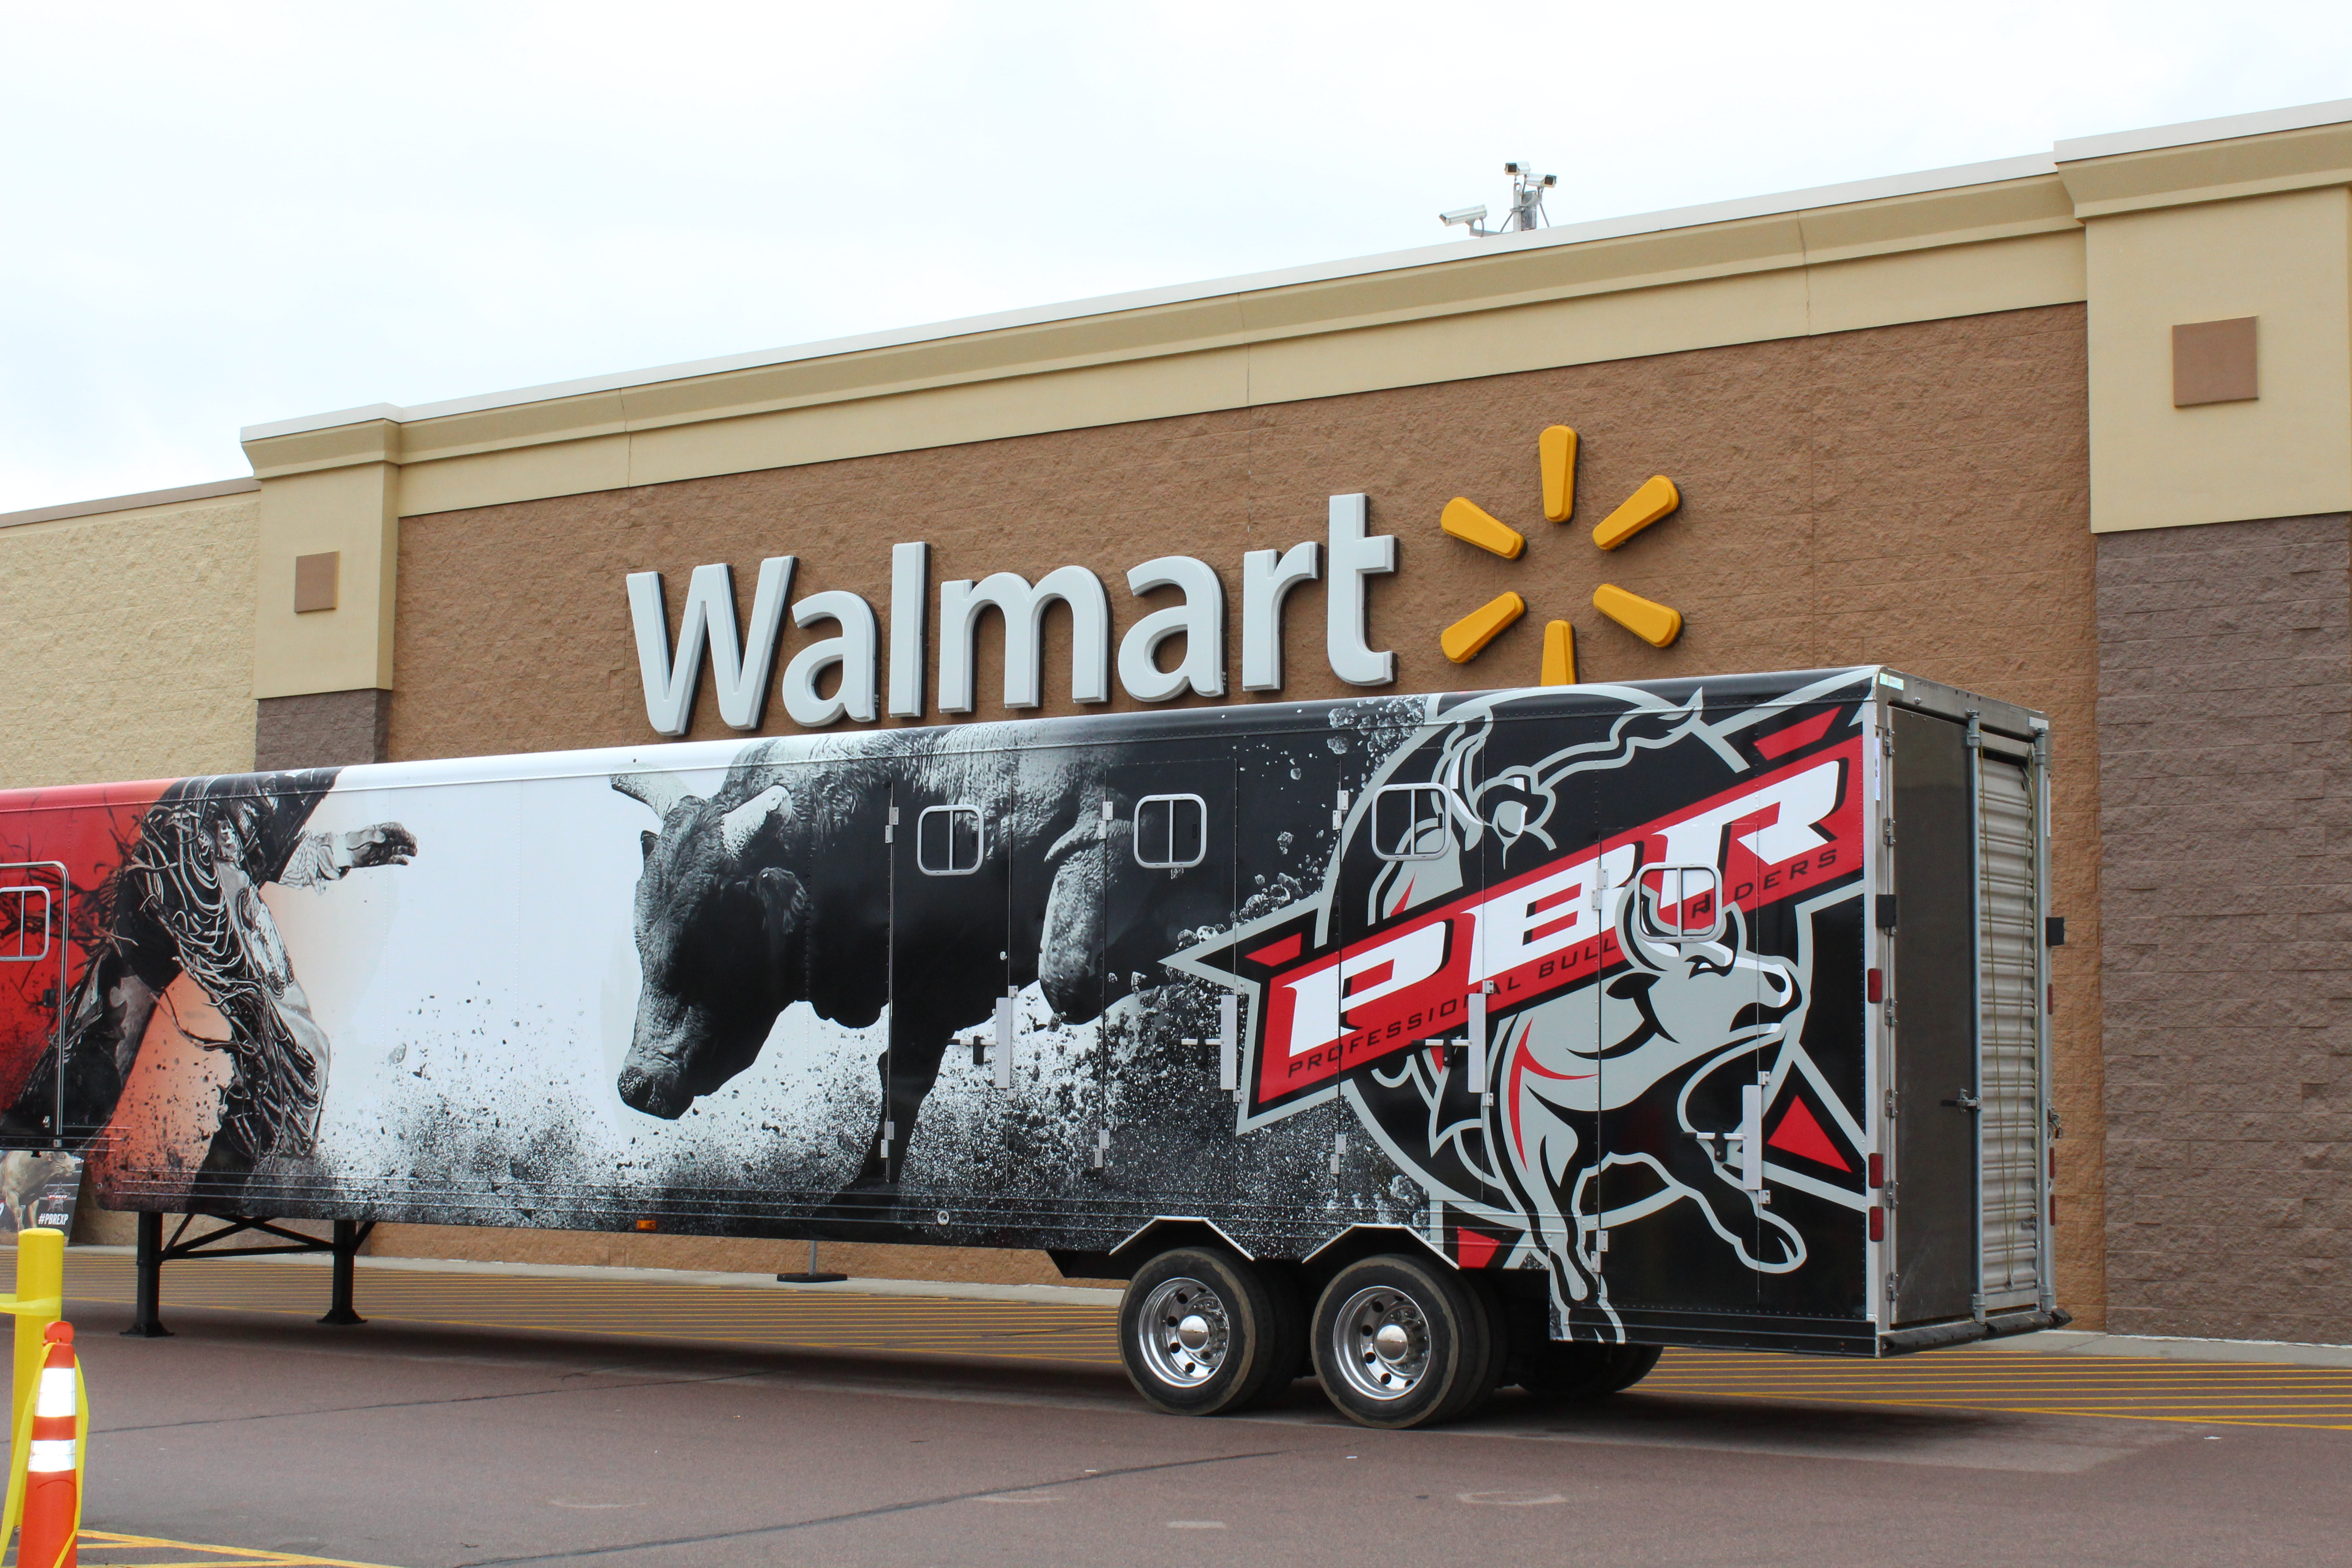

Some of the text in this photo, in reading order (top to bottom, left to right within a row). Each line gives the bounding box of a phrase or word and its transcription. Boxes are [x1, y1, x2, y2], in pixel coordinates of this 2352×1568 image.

[627, 493, 1396, 736] Walmart
[1282, 760, 1847, 1057] PBR
[1538, 938, 1617, 979] BULL
[1690, 849, 1837, 919] RDERS
[38, 1213, 69, 1225] #PBREXP
